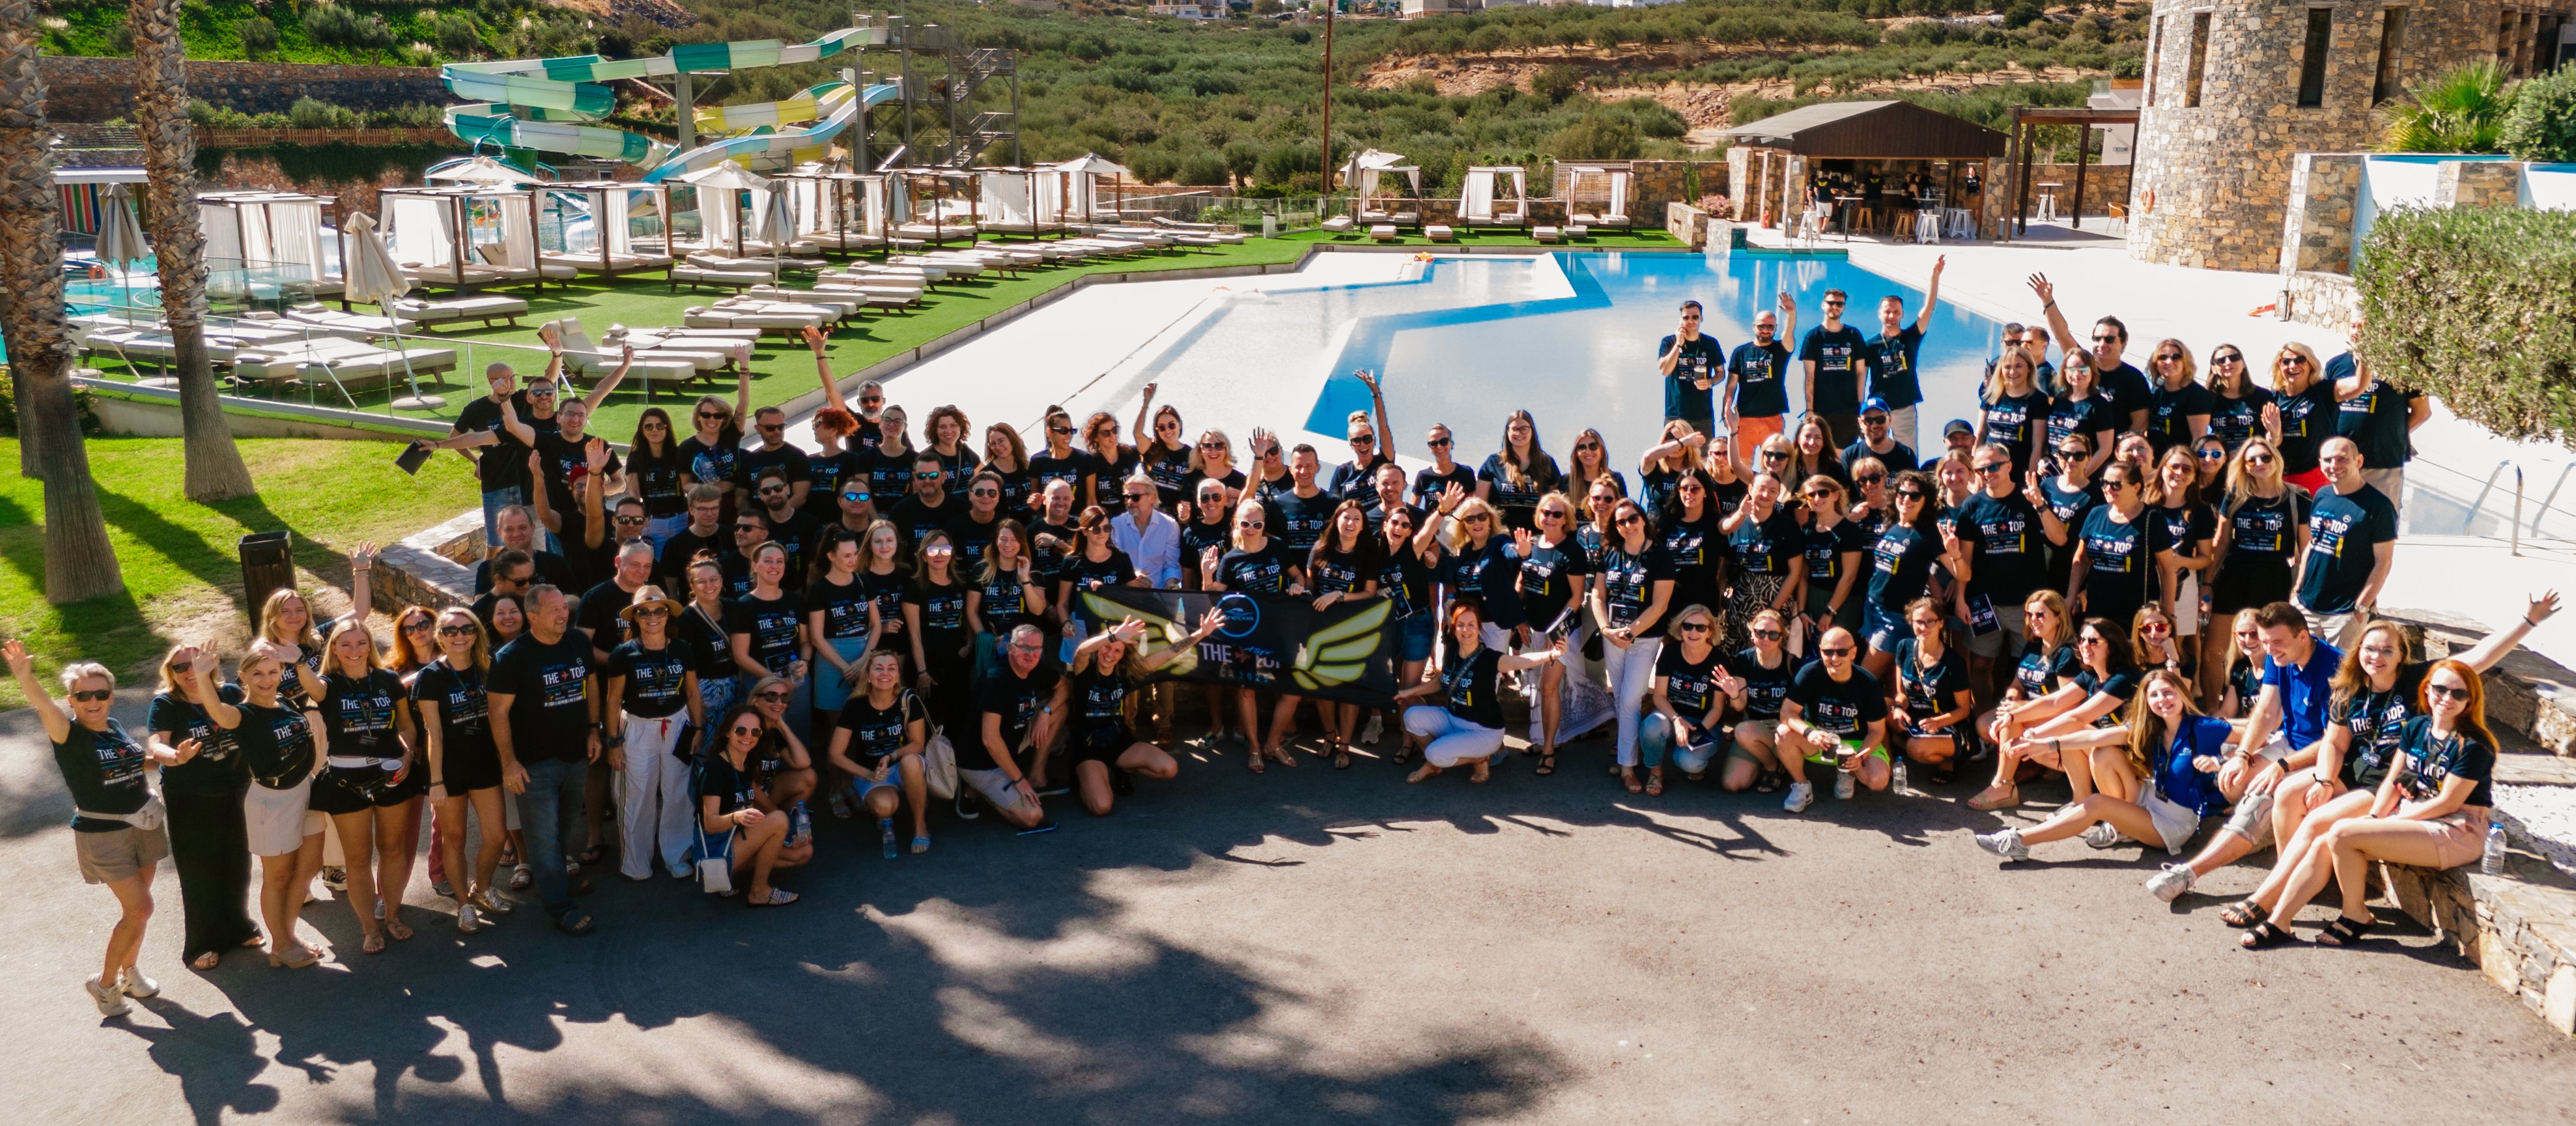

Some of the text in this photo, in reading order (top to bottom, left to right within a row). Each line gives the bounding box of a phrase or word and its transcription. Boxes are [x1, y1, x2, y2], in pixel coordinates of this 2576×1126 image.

[1987, 411, 2026, 423] THE TOP
[2292, 409, 2307, 418] TOP
[2064, 418, 2078, 429] TOP
[2213, 415, 2253, 427] THE TOP
[863, 438, 873, 447] THE
[560, 460, 572, 468] THE
[721, 453, 734, 464] TOP
[873, 472, 886, 480] THE
[1098, 481, 1110, 489] THE
[1345, 482, 1358, 491] THE
[1501, 483, 1514, 492] THE
[1723, 502, 1736, 511] TOP
[2059, 507, 2075, 519] TOP
[1287, 521, 1323, 530] THE TOP
[1981, 521, 2025, 535] THE TOP
[2237, 518, 2282, 531] THE TOP
[2330, 520, 2347, 534] TOP
[786, 543, 799, 552] TOP
[967, 546, 979, 555] THE
[1737, 544, 1748, 553] THE
[1891, 544, 1906, 554] TOP
[2088, 539, 2132, 553] THE TOP
[1038, 548, 1049, 557] THE
[1820, 550, 1832, 559] TOP
[1243, 565, 1281, 582] THE TOP
[1538, 567, 1551, 577] TOP
[1606, 571, 1644, 584] THE TOP
[1103, 576, 1116, 584] TOP
[733, 582, 748, 591] THE
[985, 587, 999, 596] THE
[830, 601, 869, 617] THE TOP
[929, 603, 942, 612] THE
[1983, 611, 1993, 621] TOP
[757, 617, 797, 630] THE TOP
[1199, 642, 1233, 663] THE
[543, 666, 586, 684] THE TOP
[636, 664, 683, 679] THE TOP
[2031, 671, 2045, 681] TOP
[1671, 677, 1707, 693] THE TOP
[449, 691, 467, 704] THE
[1088, 691, 1100, 702] THE
[1747, 687, 1786, 697] THE TOP
[341, 697, 391, 710] THE TOP
[1819, 703, 1858, 717] THE TOP
[2351, 705, 2405, 733] THE TOP
[190, 725, 210, 738] THE
[274, 725, 292, 740] THE
[860, 724, 902, 741] THE TOP
[97, 748, 118, 761] THE
